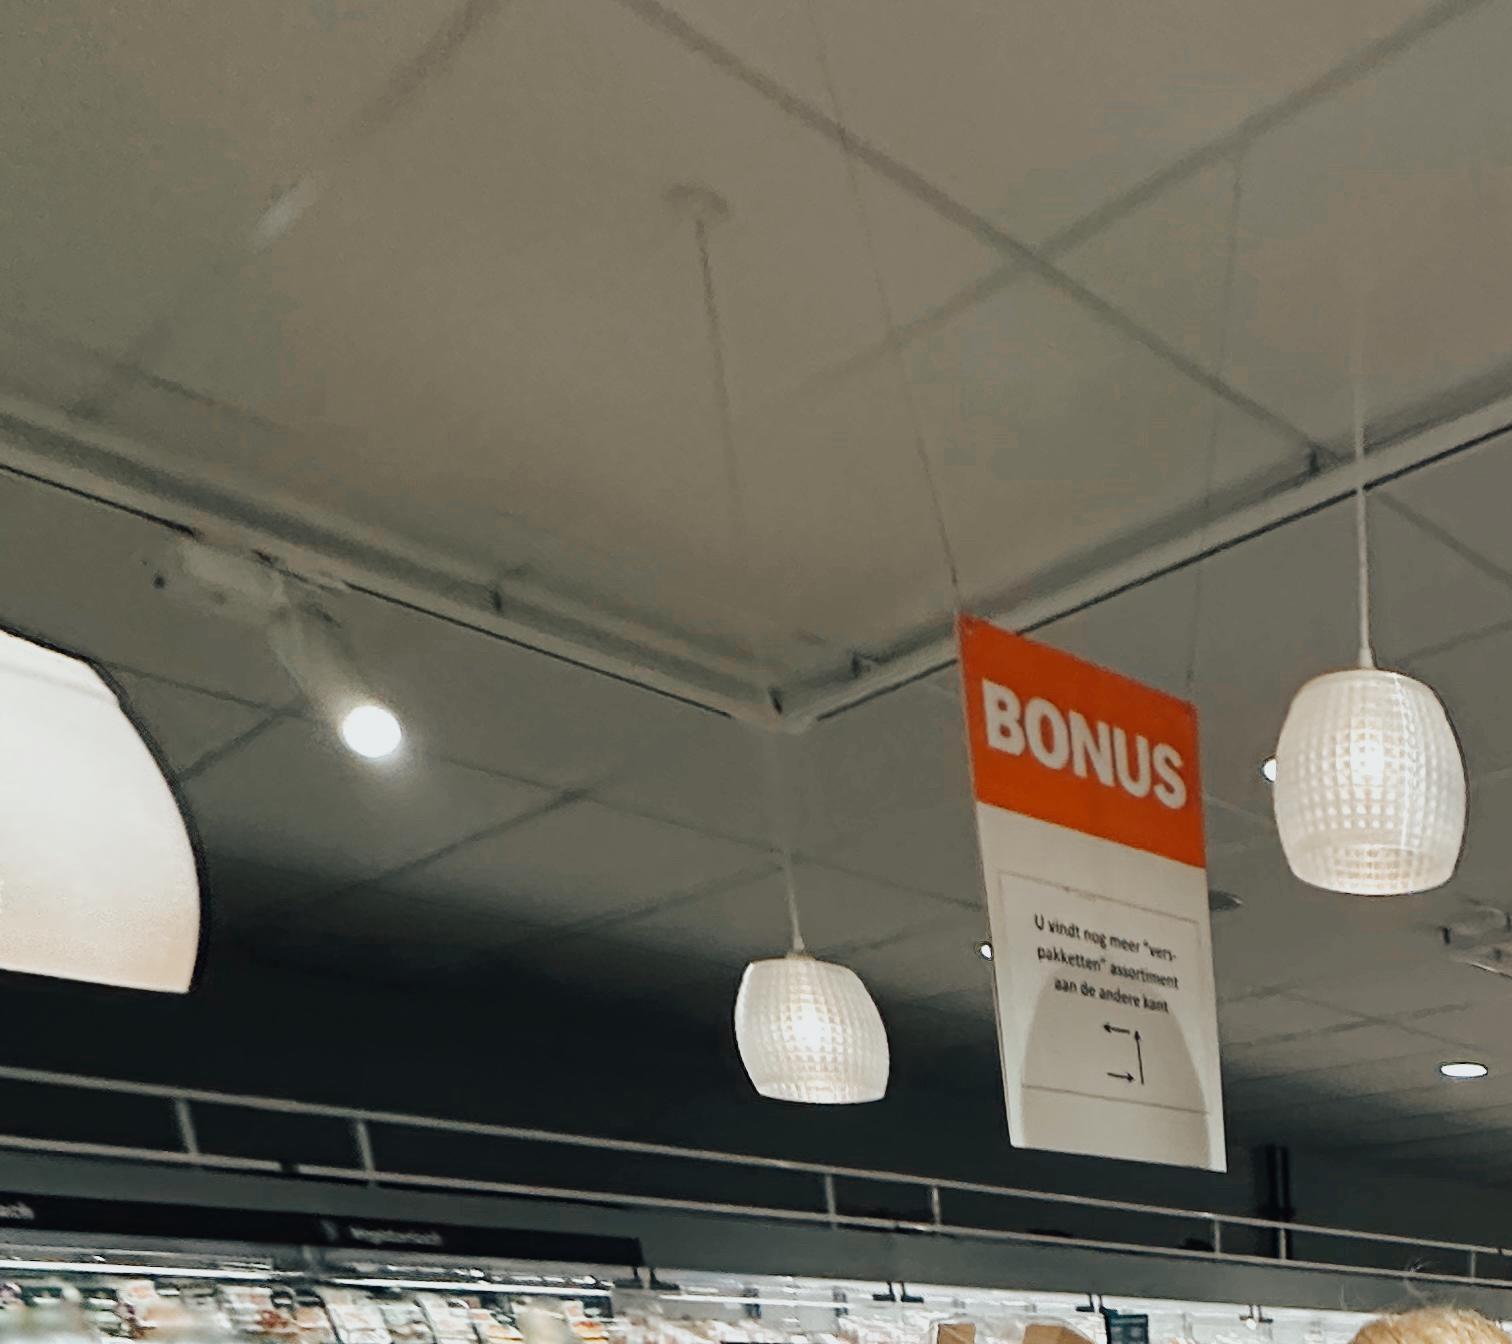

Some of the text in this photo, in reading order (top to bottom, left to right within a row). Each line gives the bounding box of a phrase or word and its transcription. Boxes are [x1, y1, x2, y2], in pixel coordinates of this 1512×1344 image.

[982, 677, 1187, 810] BONUS
[1034, 913, 1045, 931] U
[1048, 920, 1080, 940] vindt
[1083, 929, 1107, 949] nog
[1110, 935, 1140, 953] meer
[1110, 962, 1179, 990] assortiment
[1054, 978, 1169, 1014] aan de andere kant
